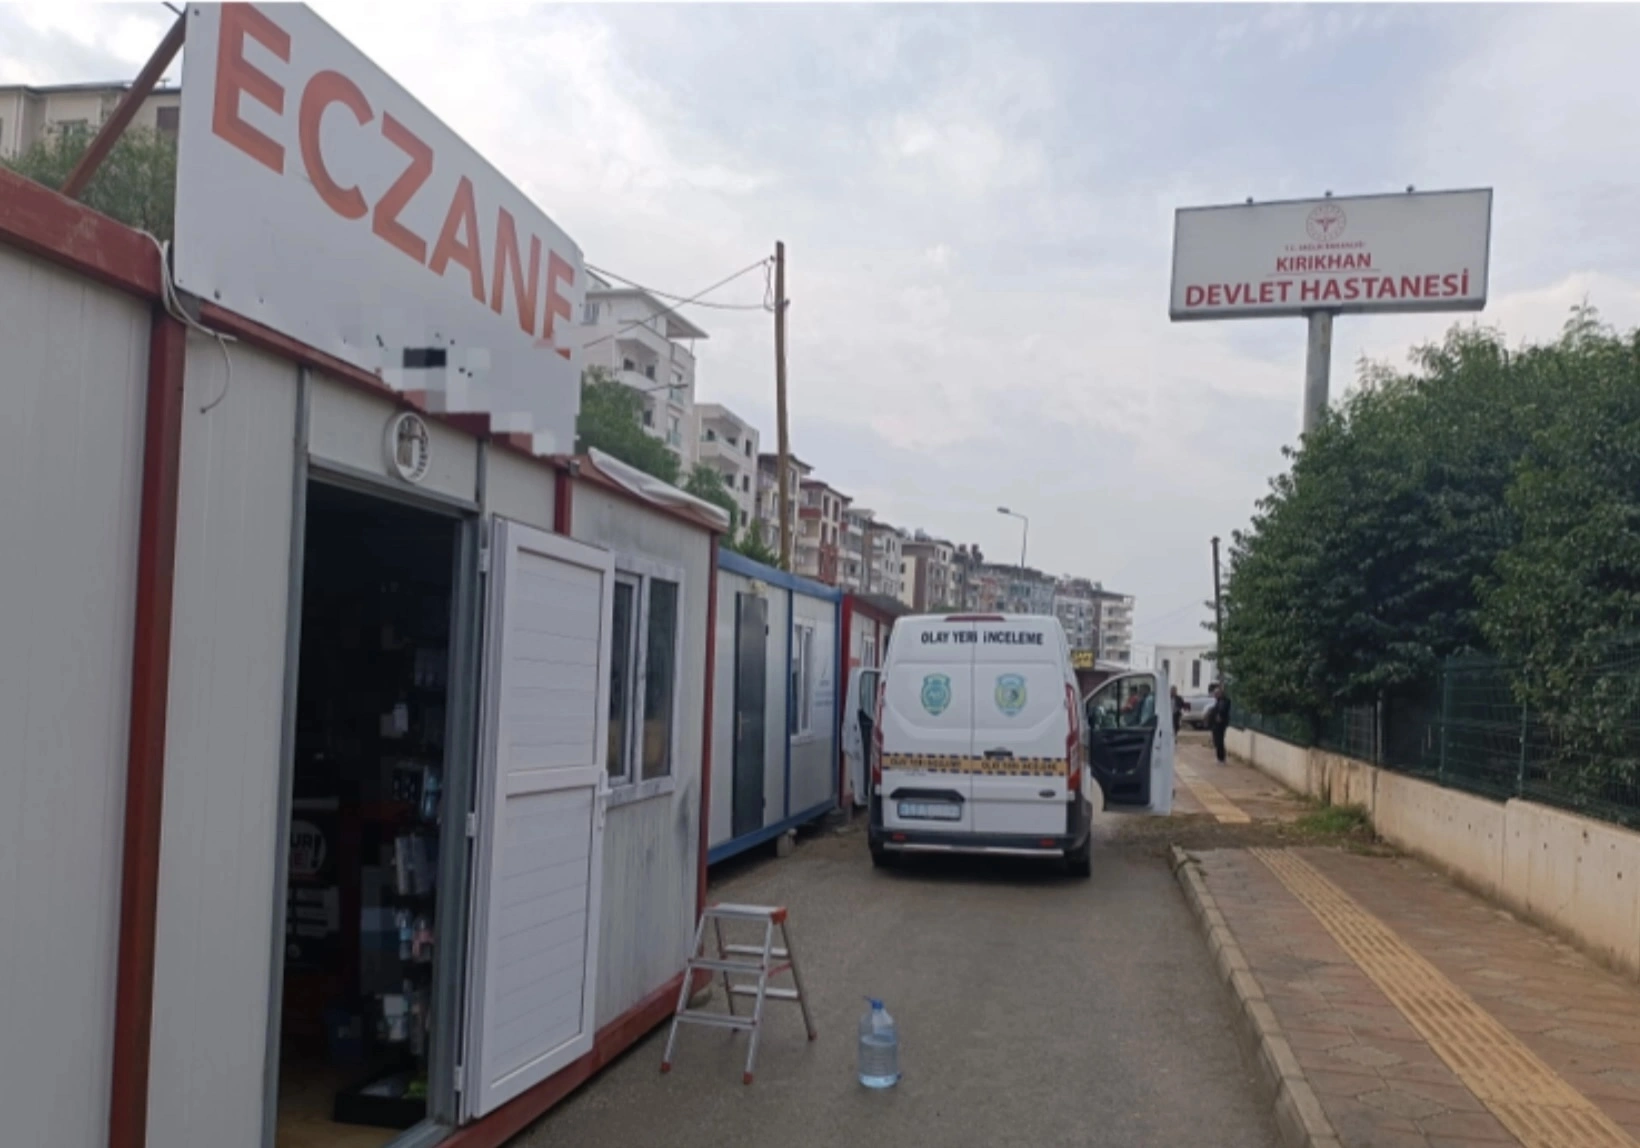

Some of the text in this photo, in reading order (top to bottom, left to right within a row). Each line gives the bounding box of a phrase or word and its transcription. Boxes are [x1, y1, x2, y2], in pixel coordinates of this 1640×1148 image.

[212, 2, 576, 361] ECZANE
[1276, 252, 1372, 272] KIRIKHAN
[1185, 268, 1470, 307] DEVLET HASTANESİ
[920, 630, 949, 645] OLAY
[982, 630, 1044, 646] İNCELEME
